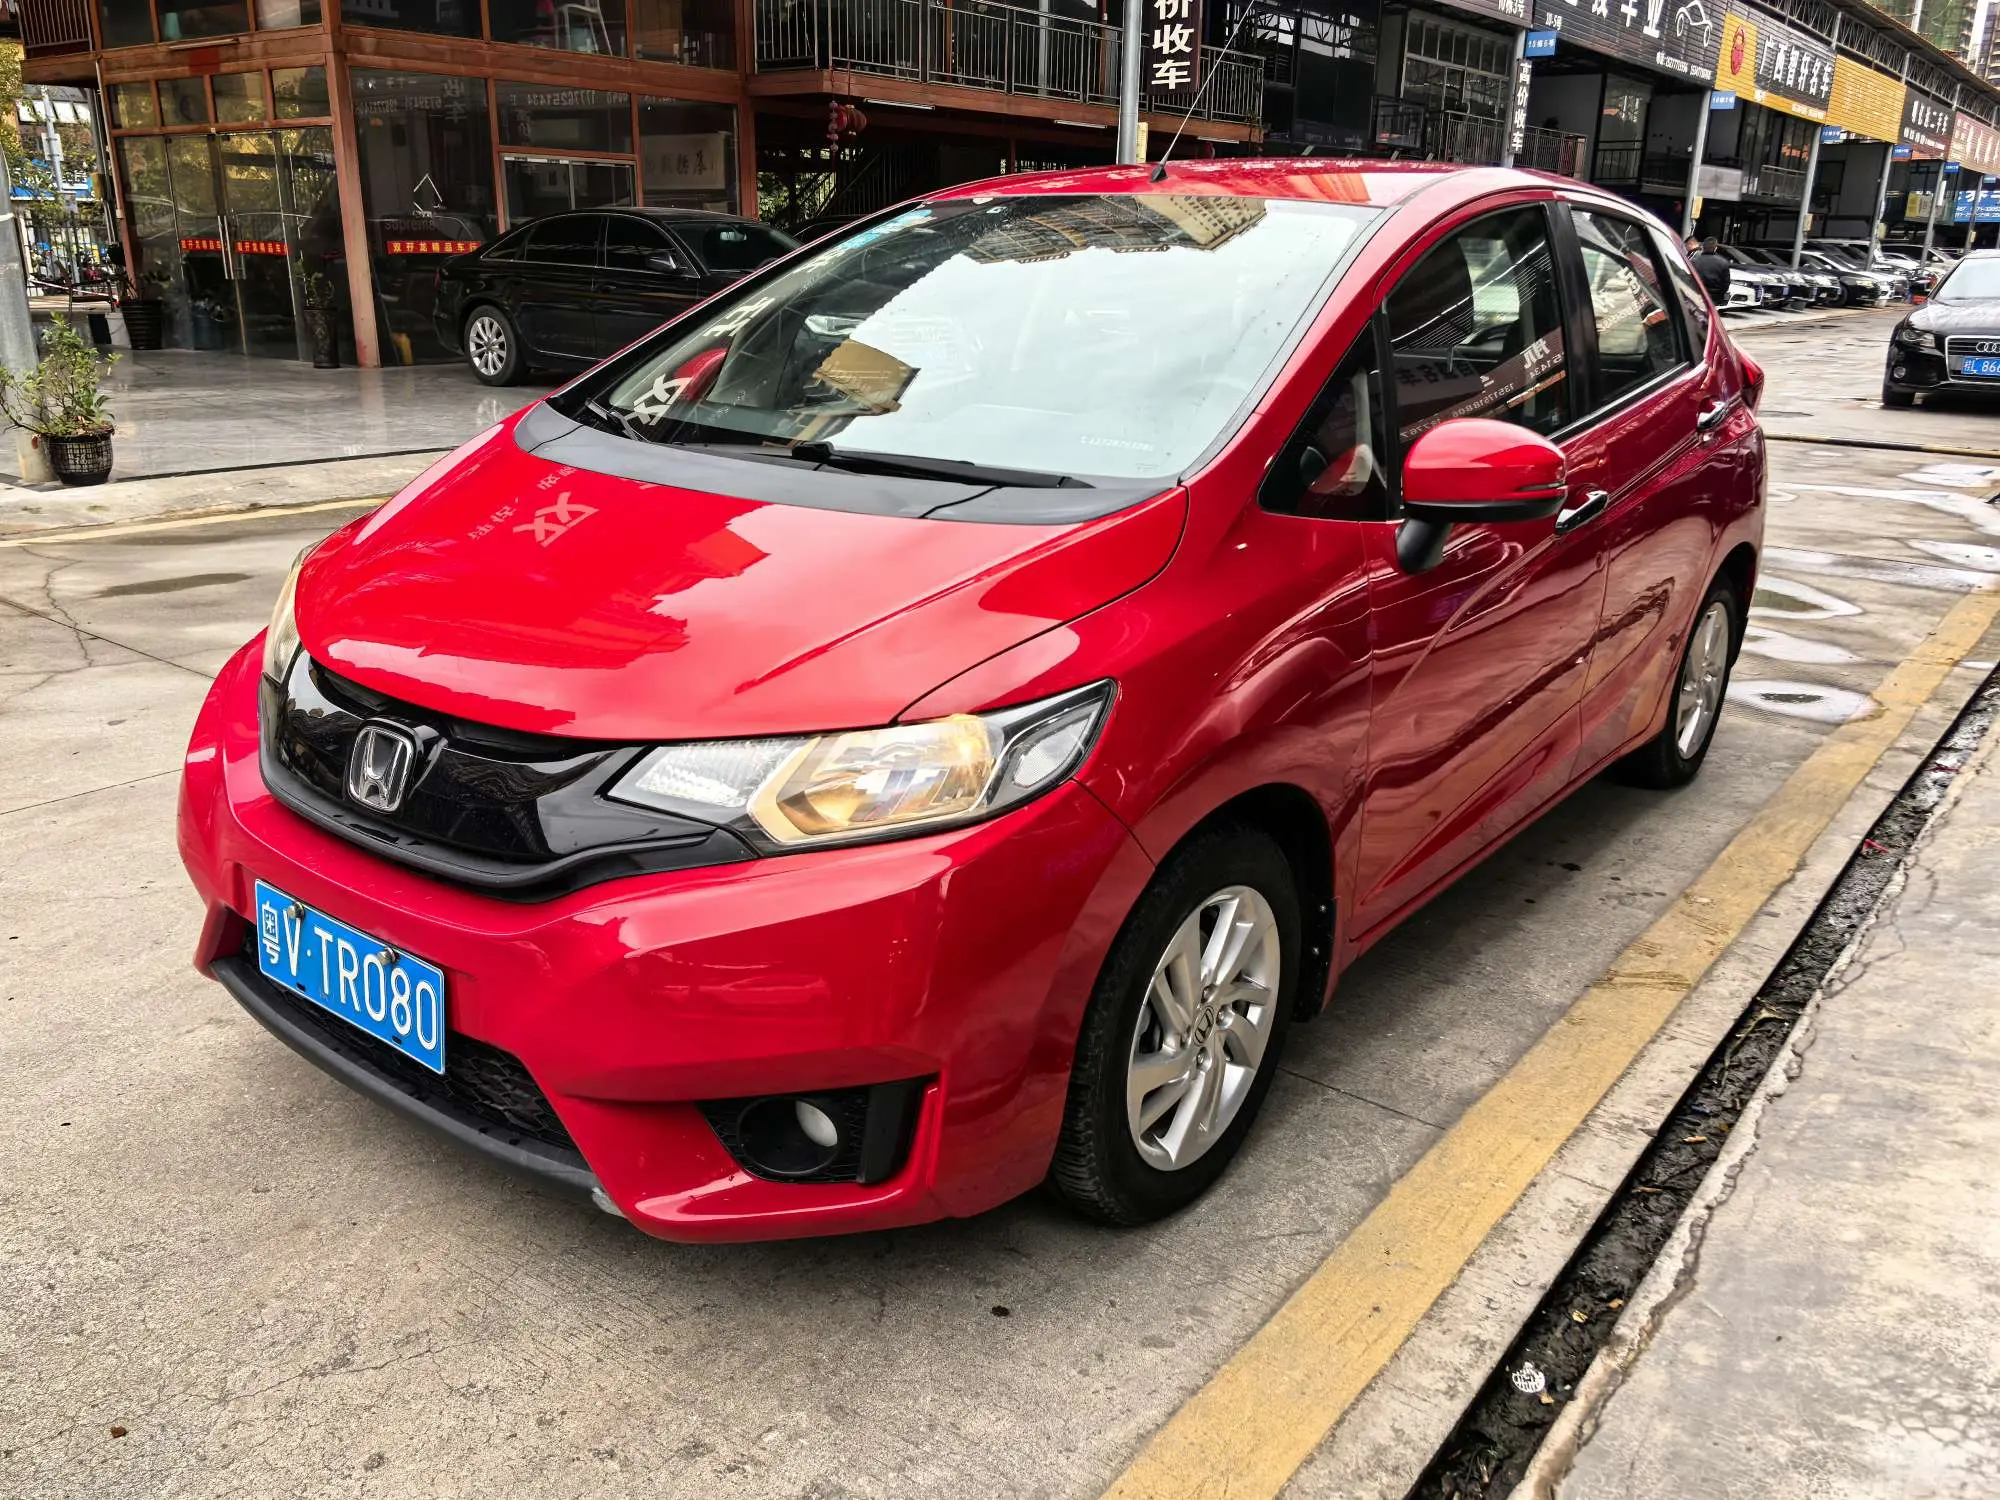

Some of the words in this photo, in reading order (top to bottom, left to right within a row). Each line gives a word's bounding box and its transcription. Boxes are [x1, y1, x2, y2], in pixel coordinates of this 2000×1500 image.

[1151, 0, 1195, 90] 价收车
[1511, 62, 1532, 151] 高价收车
[261, 900, 438, 1051] 粤V·TR080
